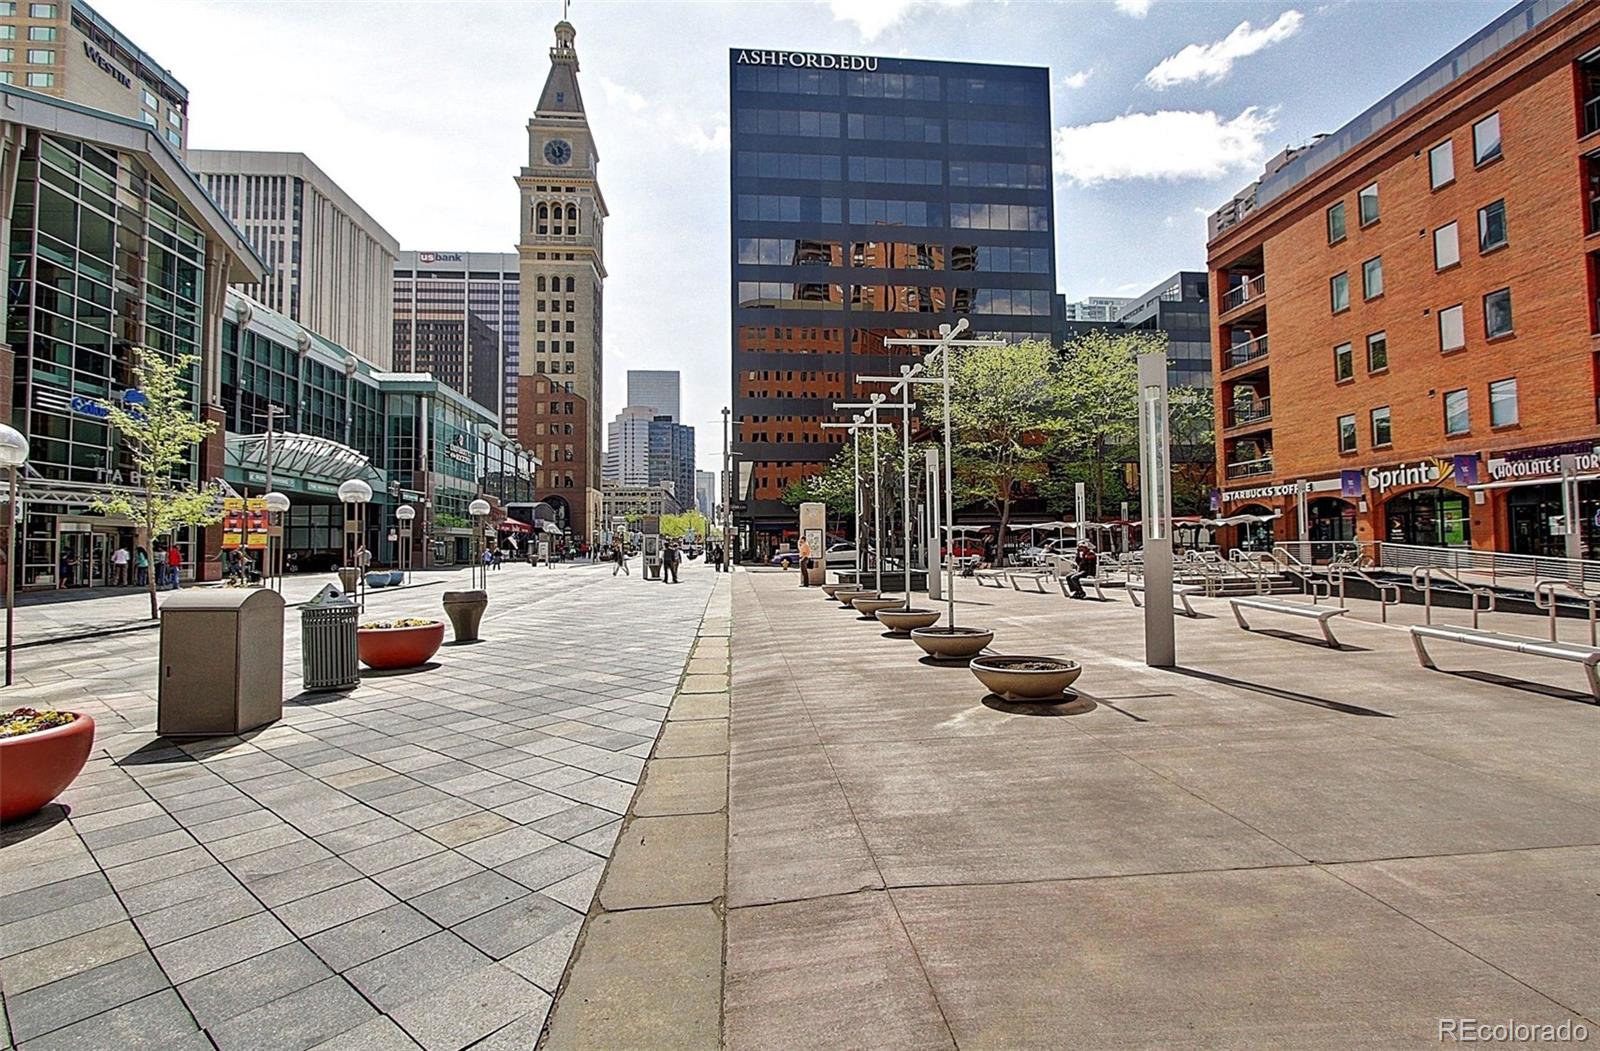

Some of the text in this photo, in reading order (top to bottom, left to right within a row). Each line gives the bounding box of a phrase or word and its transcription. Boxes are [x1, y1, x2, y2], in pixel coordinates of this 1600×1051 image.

[83, 41, 131, 89] WESTIN
[737, 50, 878, 71] ASHFORD.EDU
[1368, 462, 1430, 493] Sprint
[1493, 458, 1551, 480] CHOCOLATE
[1553, 453, 1600, 473] FTOR
[1224, 487, 1274, 502] STARBUCKS
[1276, 482, 1311, 497] COFFE
